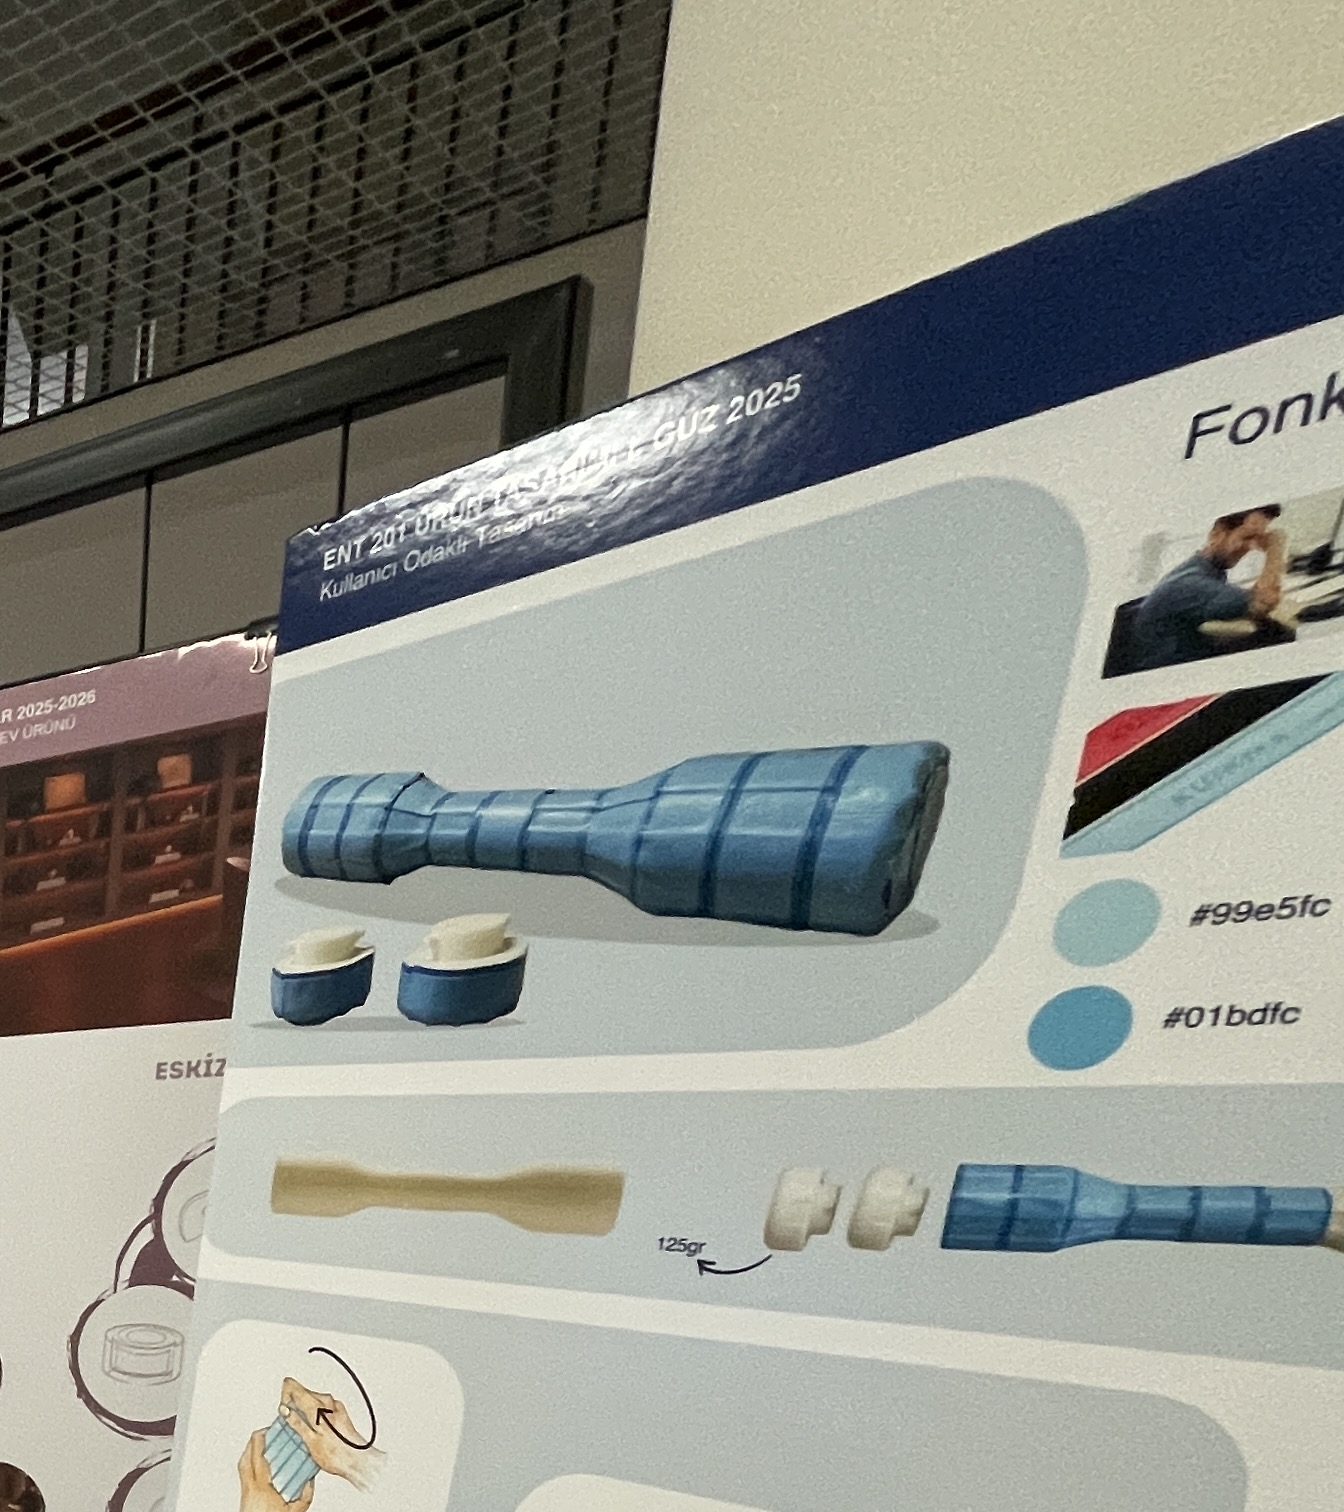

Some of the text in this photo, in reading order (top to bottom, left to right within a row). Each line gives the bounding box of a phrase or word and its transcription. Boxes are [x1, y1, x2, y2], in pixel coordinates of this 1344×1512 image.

[323, 538, 365, 571] ENT
[726, 373, 802, 424] 2025
[319, 562, 397, 602] Kullanıcı
[16, 689, 97, 720] 2025-2026
[1188, 893, 1332, 928] #99e5fc
[1162, 1001, 1302, 1031] #01bdfc
[155, 1052, 227, 1080] ESKİZ
[658, 1236, 707, 1257] 125gr
